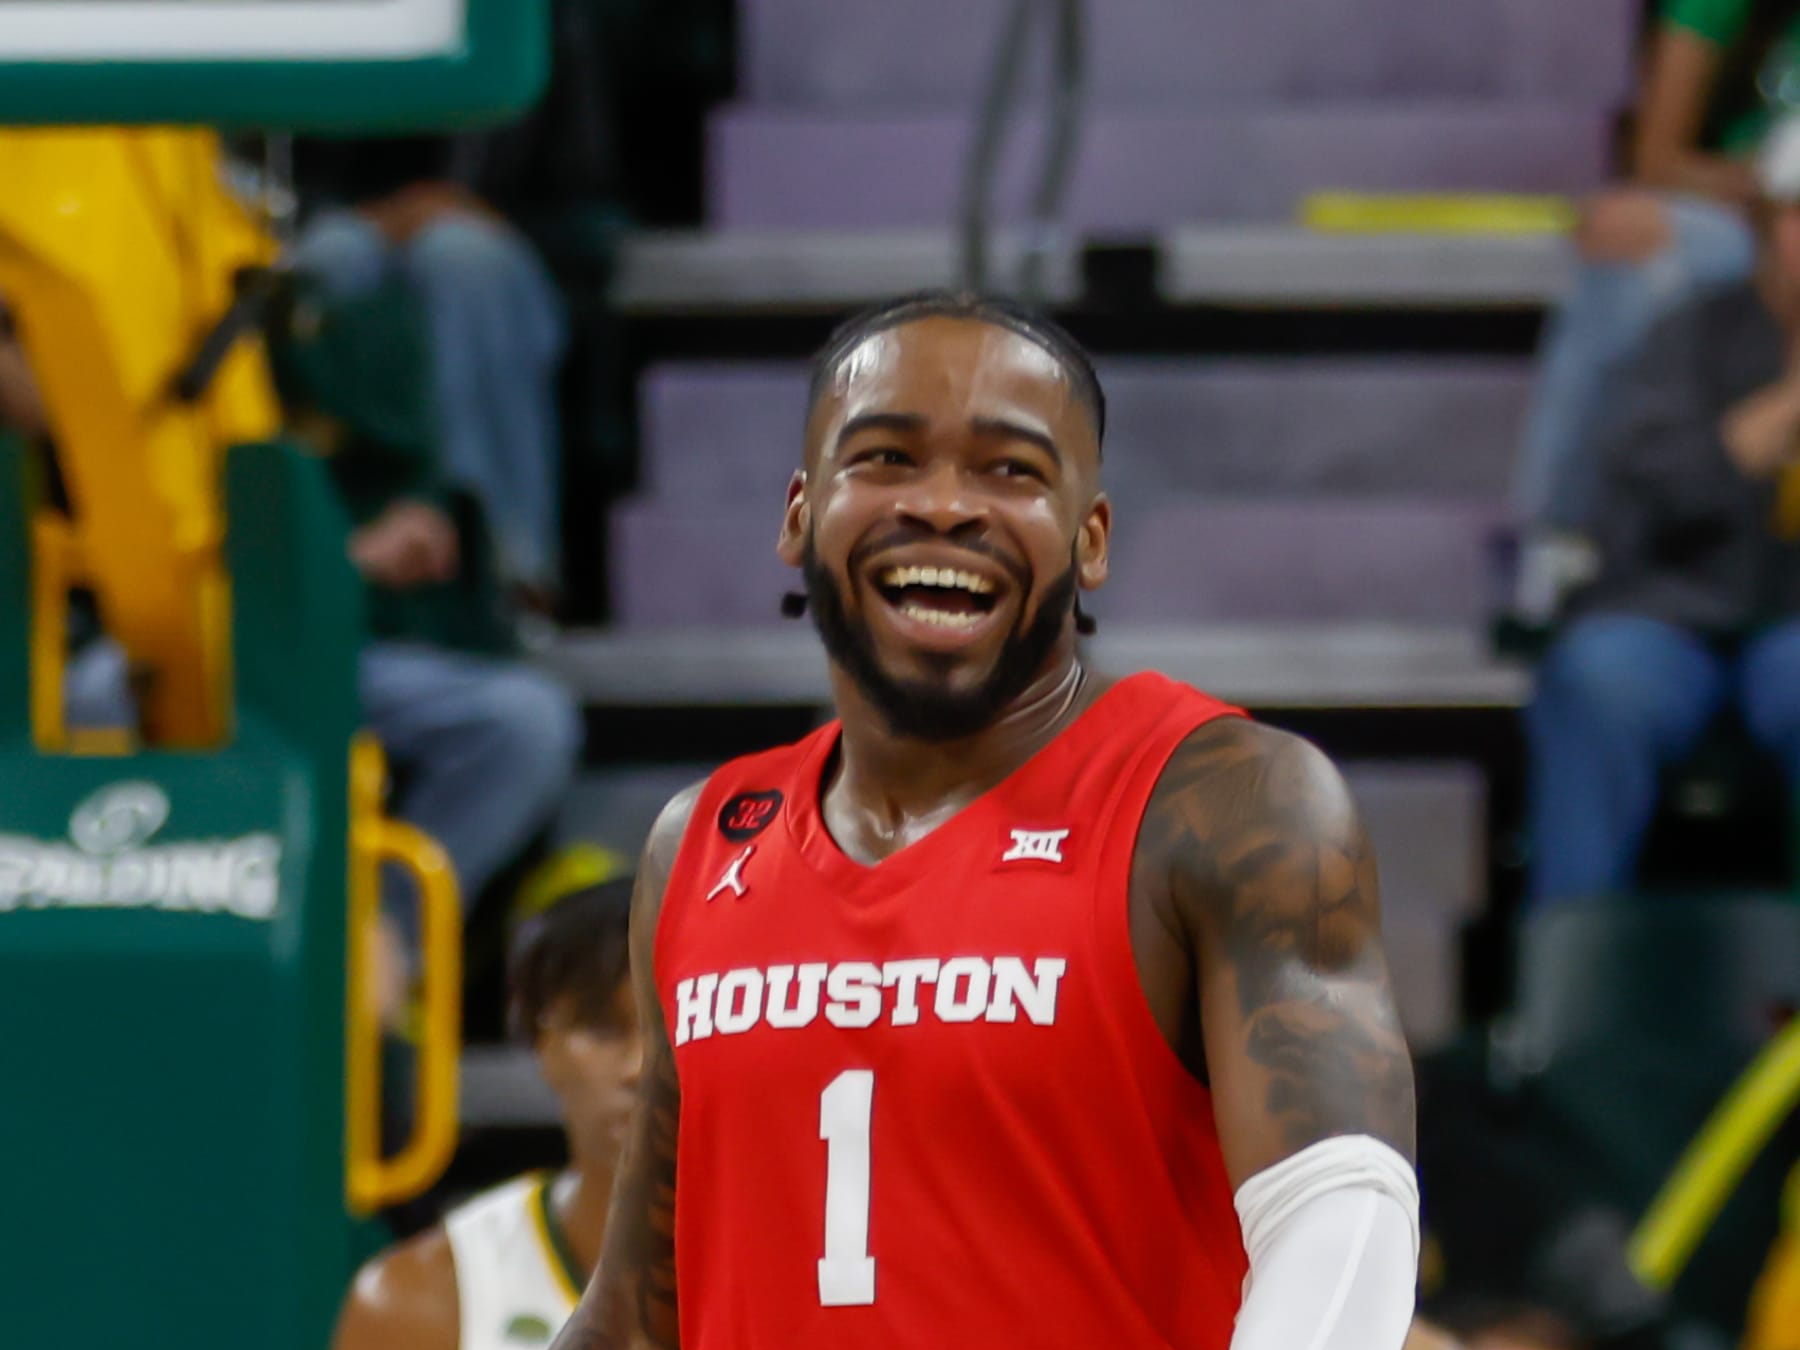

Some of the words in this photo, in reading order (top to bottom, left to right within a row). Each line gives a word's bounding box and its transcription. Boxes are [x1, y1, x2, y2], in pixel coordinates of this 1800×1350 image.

[1002, 828, 1070, 863] XII
[675, 956, 1066, 1047] HOUSTON
[817, 1069, 876, 1307] 1
